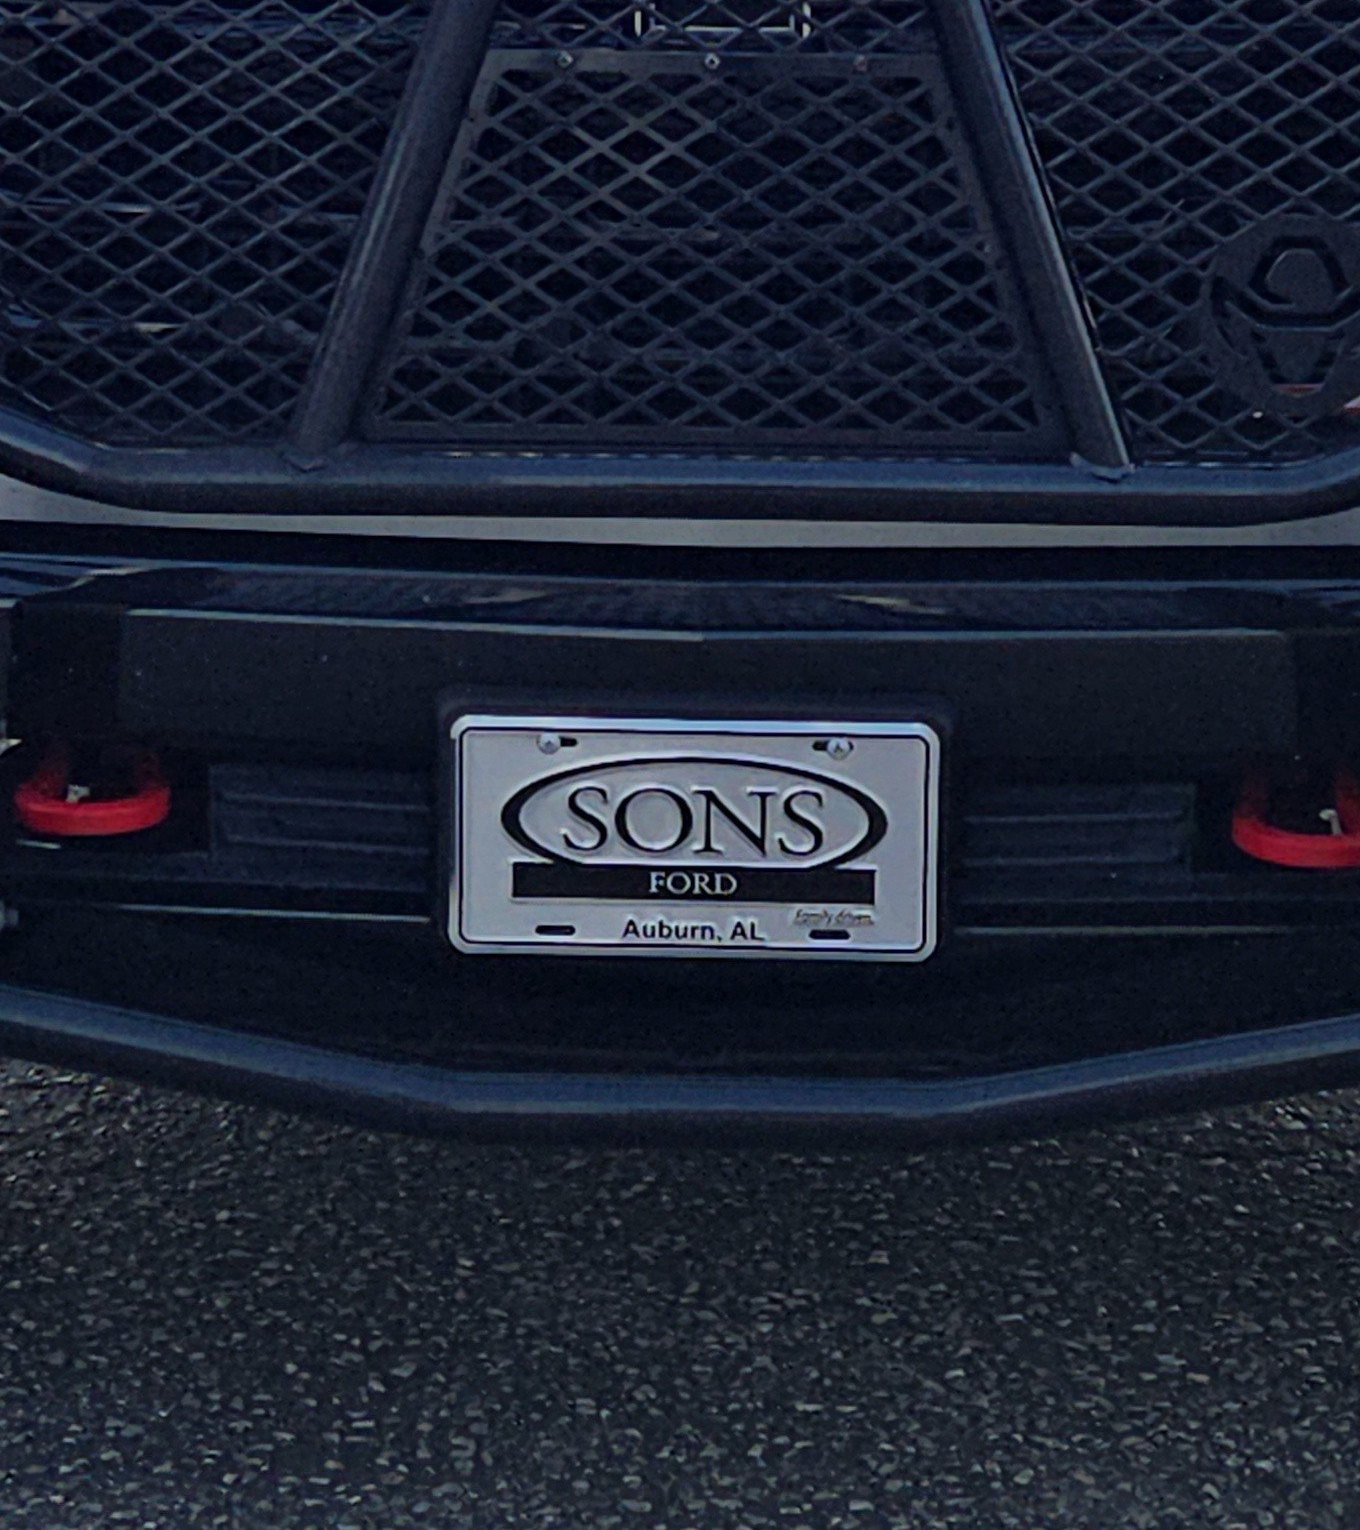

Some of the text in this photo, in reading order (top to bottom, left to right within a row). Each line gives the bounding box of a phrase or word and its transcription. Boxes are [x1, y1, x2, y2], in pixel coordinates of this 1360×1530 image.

[562, 785, 825, 858] SONS
[648, 870, 738, 897] FORD
[622, 919, 766, 941] Auburn, AL
